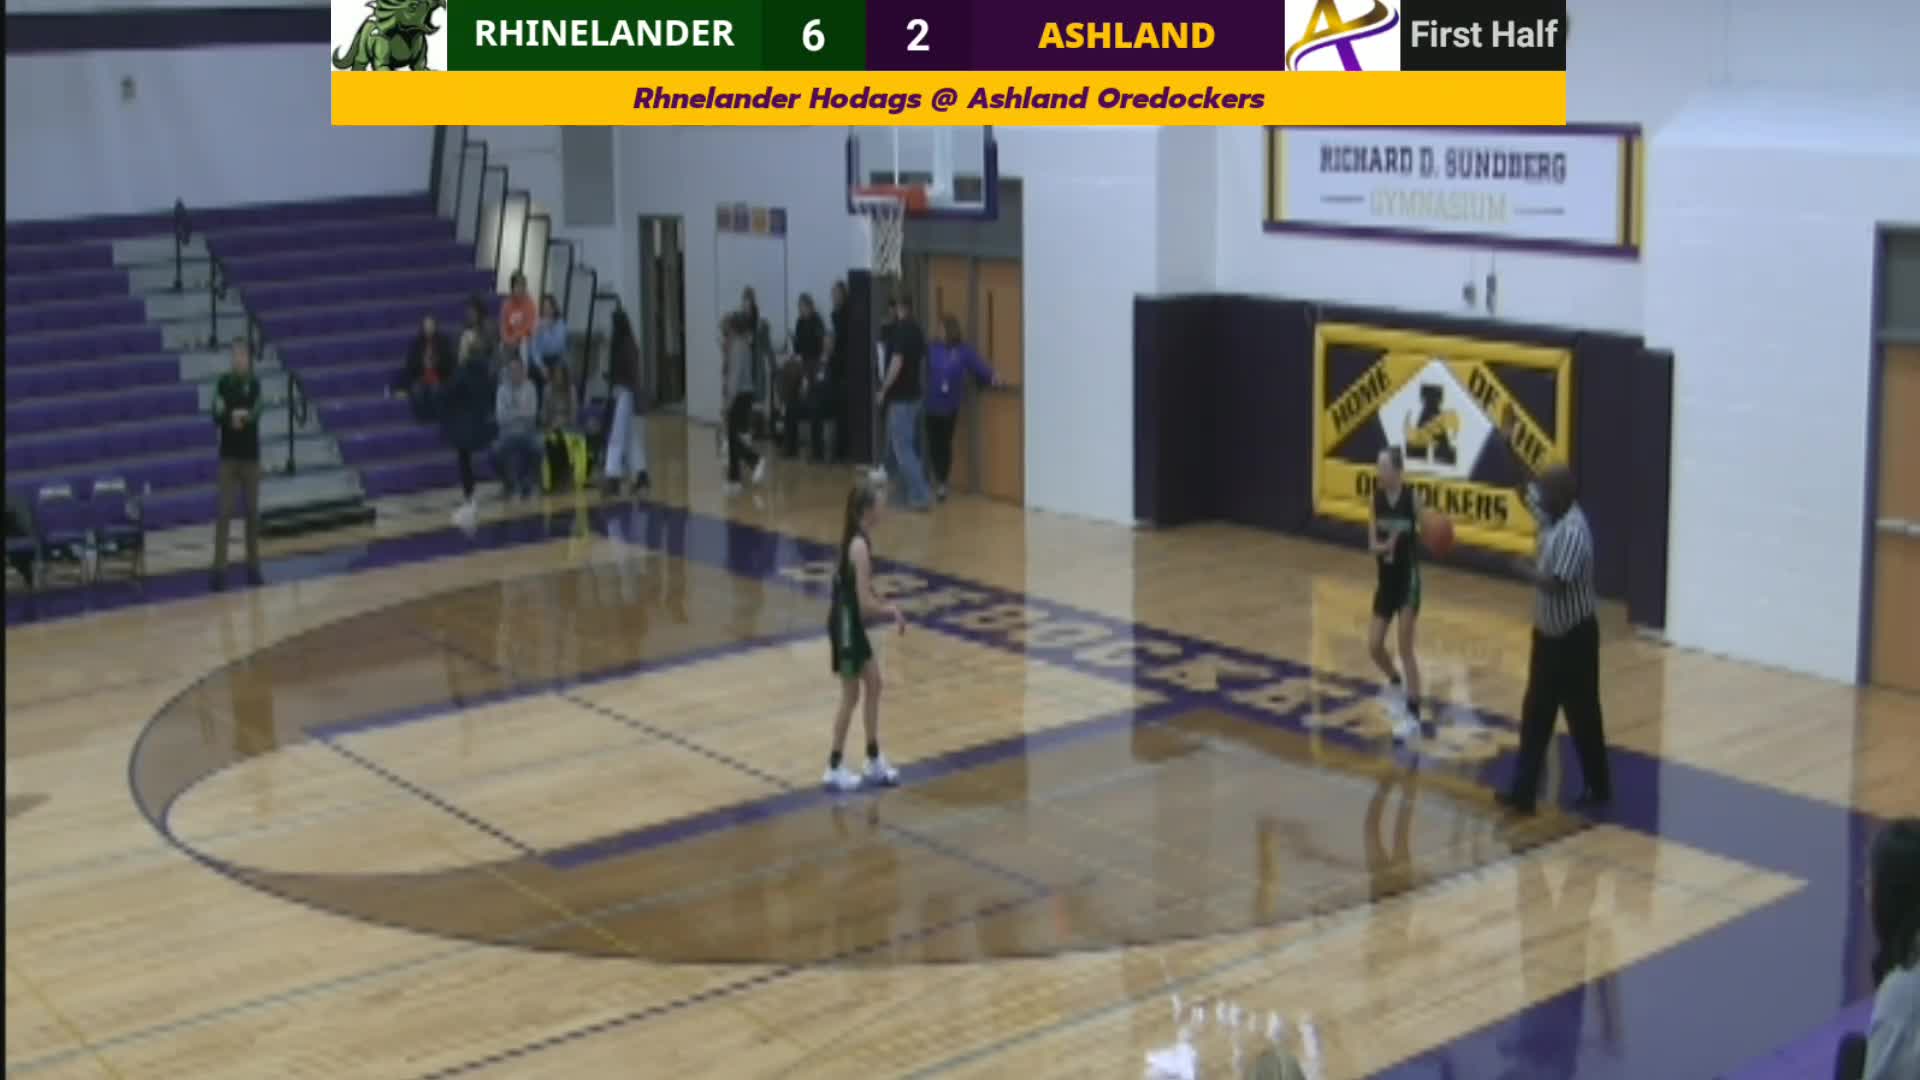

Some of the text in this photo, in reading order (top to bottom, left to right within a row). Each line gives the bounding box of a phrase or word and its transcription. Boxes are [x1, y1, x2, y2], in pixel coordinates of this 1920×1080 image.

[1319, 144, 1567, 185] RICHARD D. SUNDBERG
[1369, 189, 1509, 224] GYMNASIUM
[1331, 367, 1391, 433] HOME
